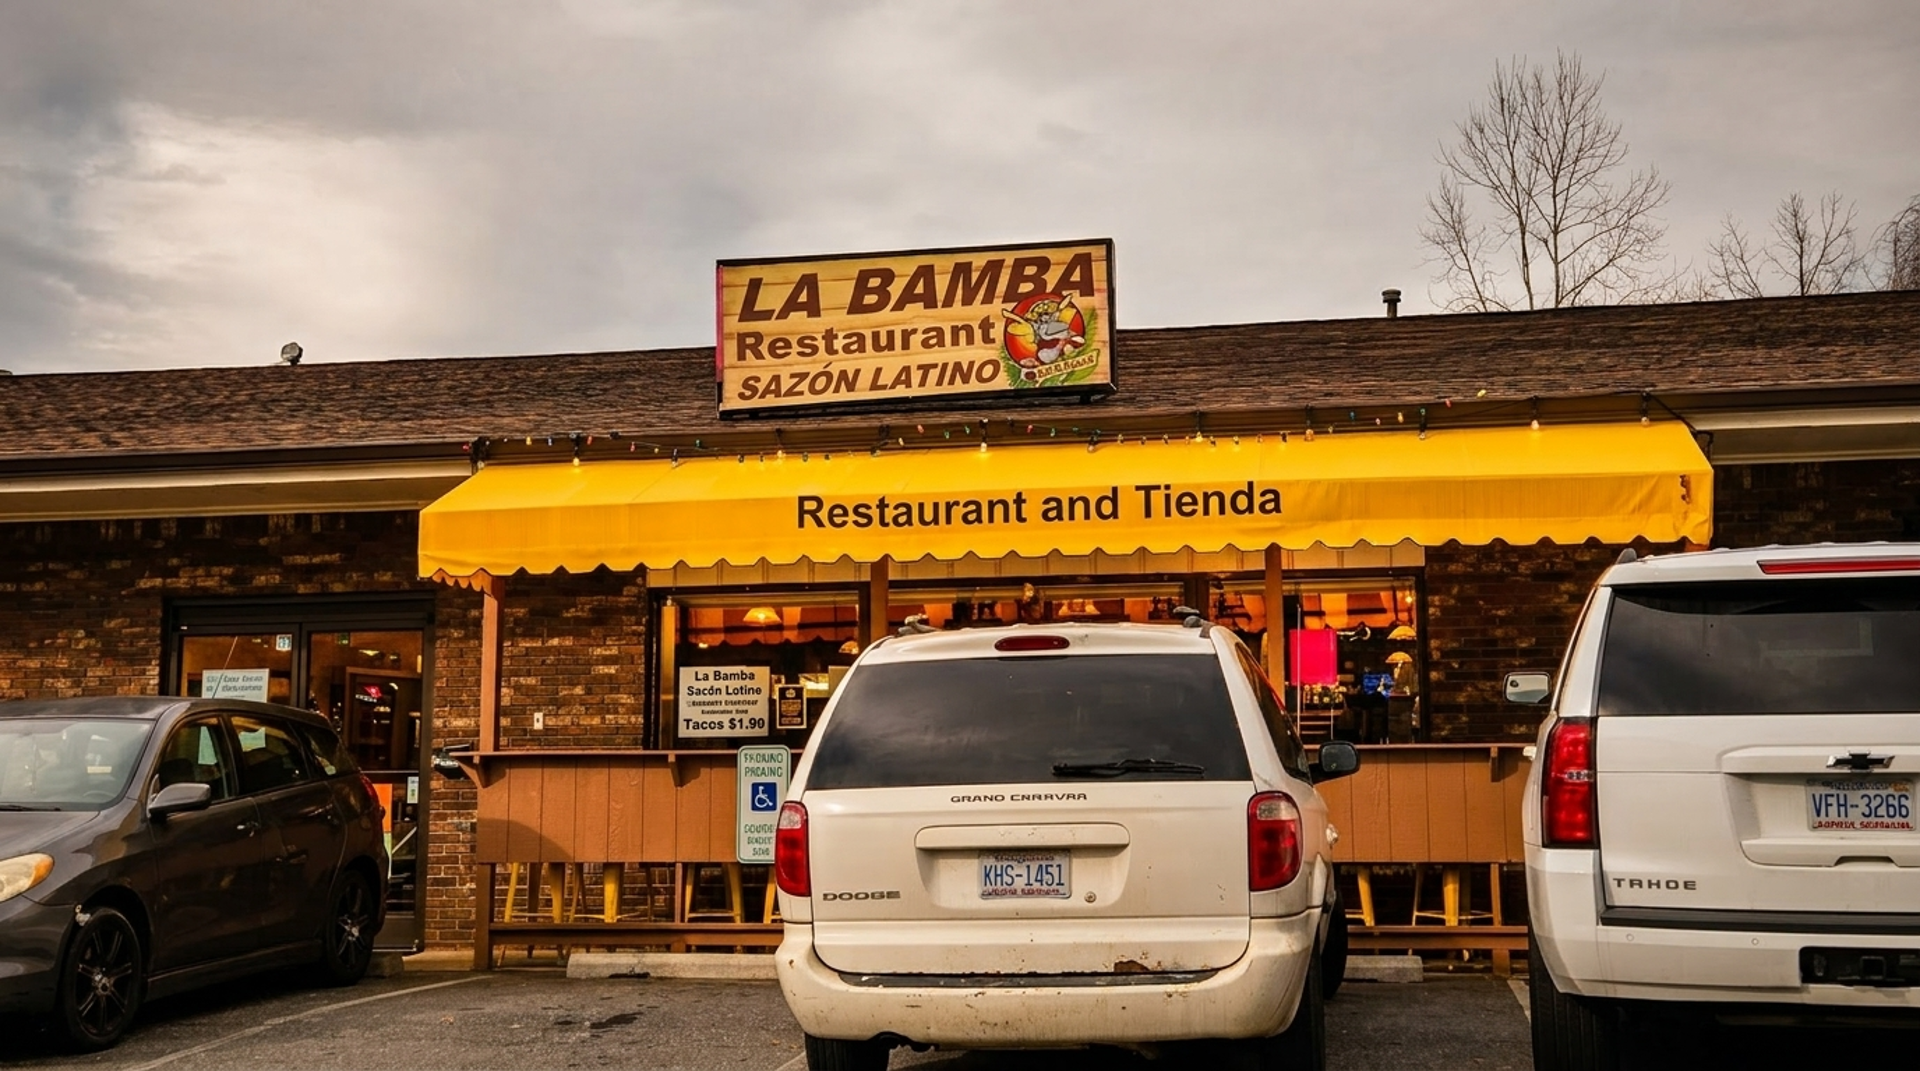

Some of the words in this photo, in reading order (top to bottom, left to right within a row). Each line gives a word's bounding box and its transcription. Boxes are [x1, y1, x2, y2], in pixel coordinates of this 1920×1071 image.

[737, 272, 822, 323] LA
[846, 252, 1095, 315] BAMBA
[736, 314, 997, 362] Restaurant
[737, 361, 860, 401] SAZÓN
[868, 358, 1001, 392] LATINO
[797, 491, 1028, 529] Restaurant
[1040, 486, 1119, 521] and
[1135, 481, 1283, 519] Tienda
[694, 670, 709, 681] La
[713, 670, 756, 681] Bamba
[683, 718, 725, 730] Tacos
[1811, 792, 1911, 819] VFH-3266
[983, 863, 1066, 887] KHS-1451
[1612, 877, 1697, 891] TAHOE
